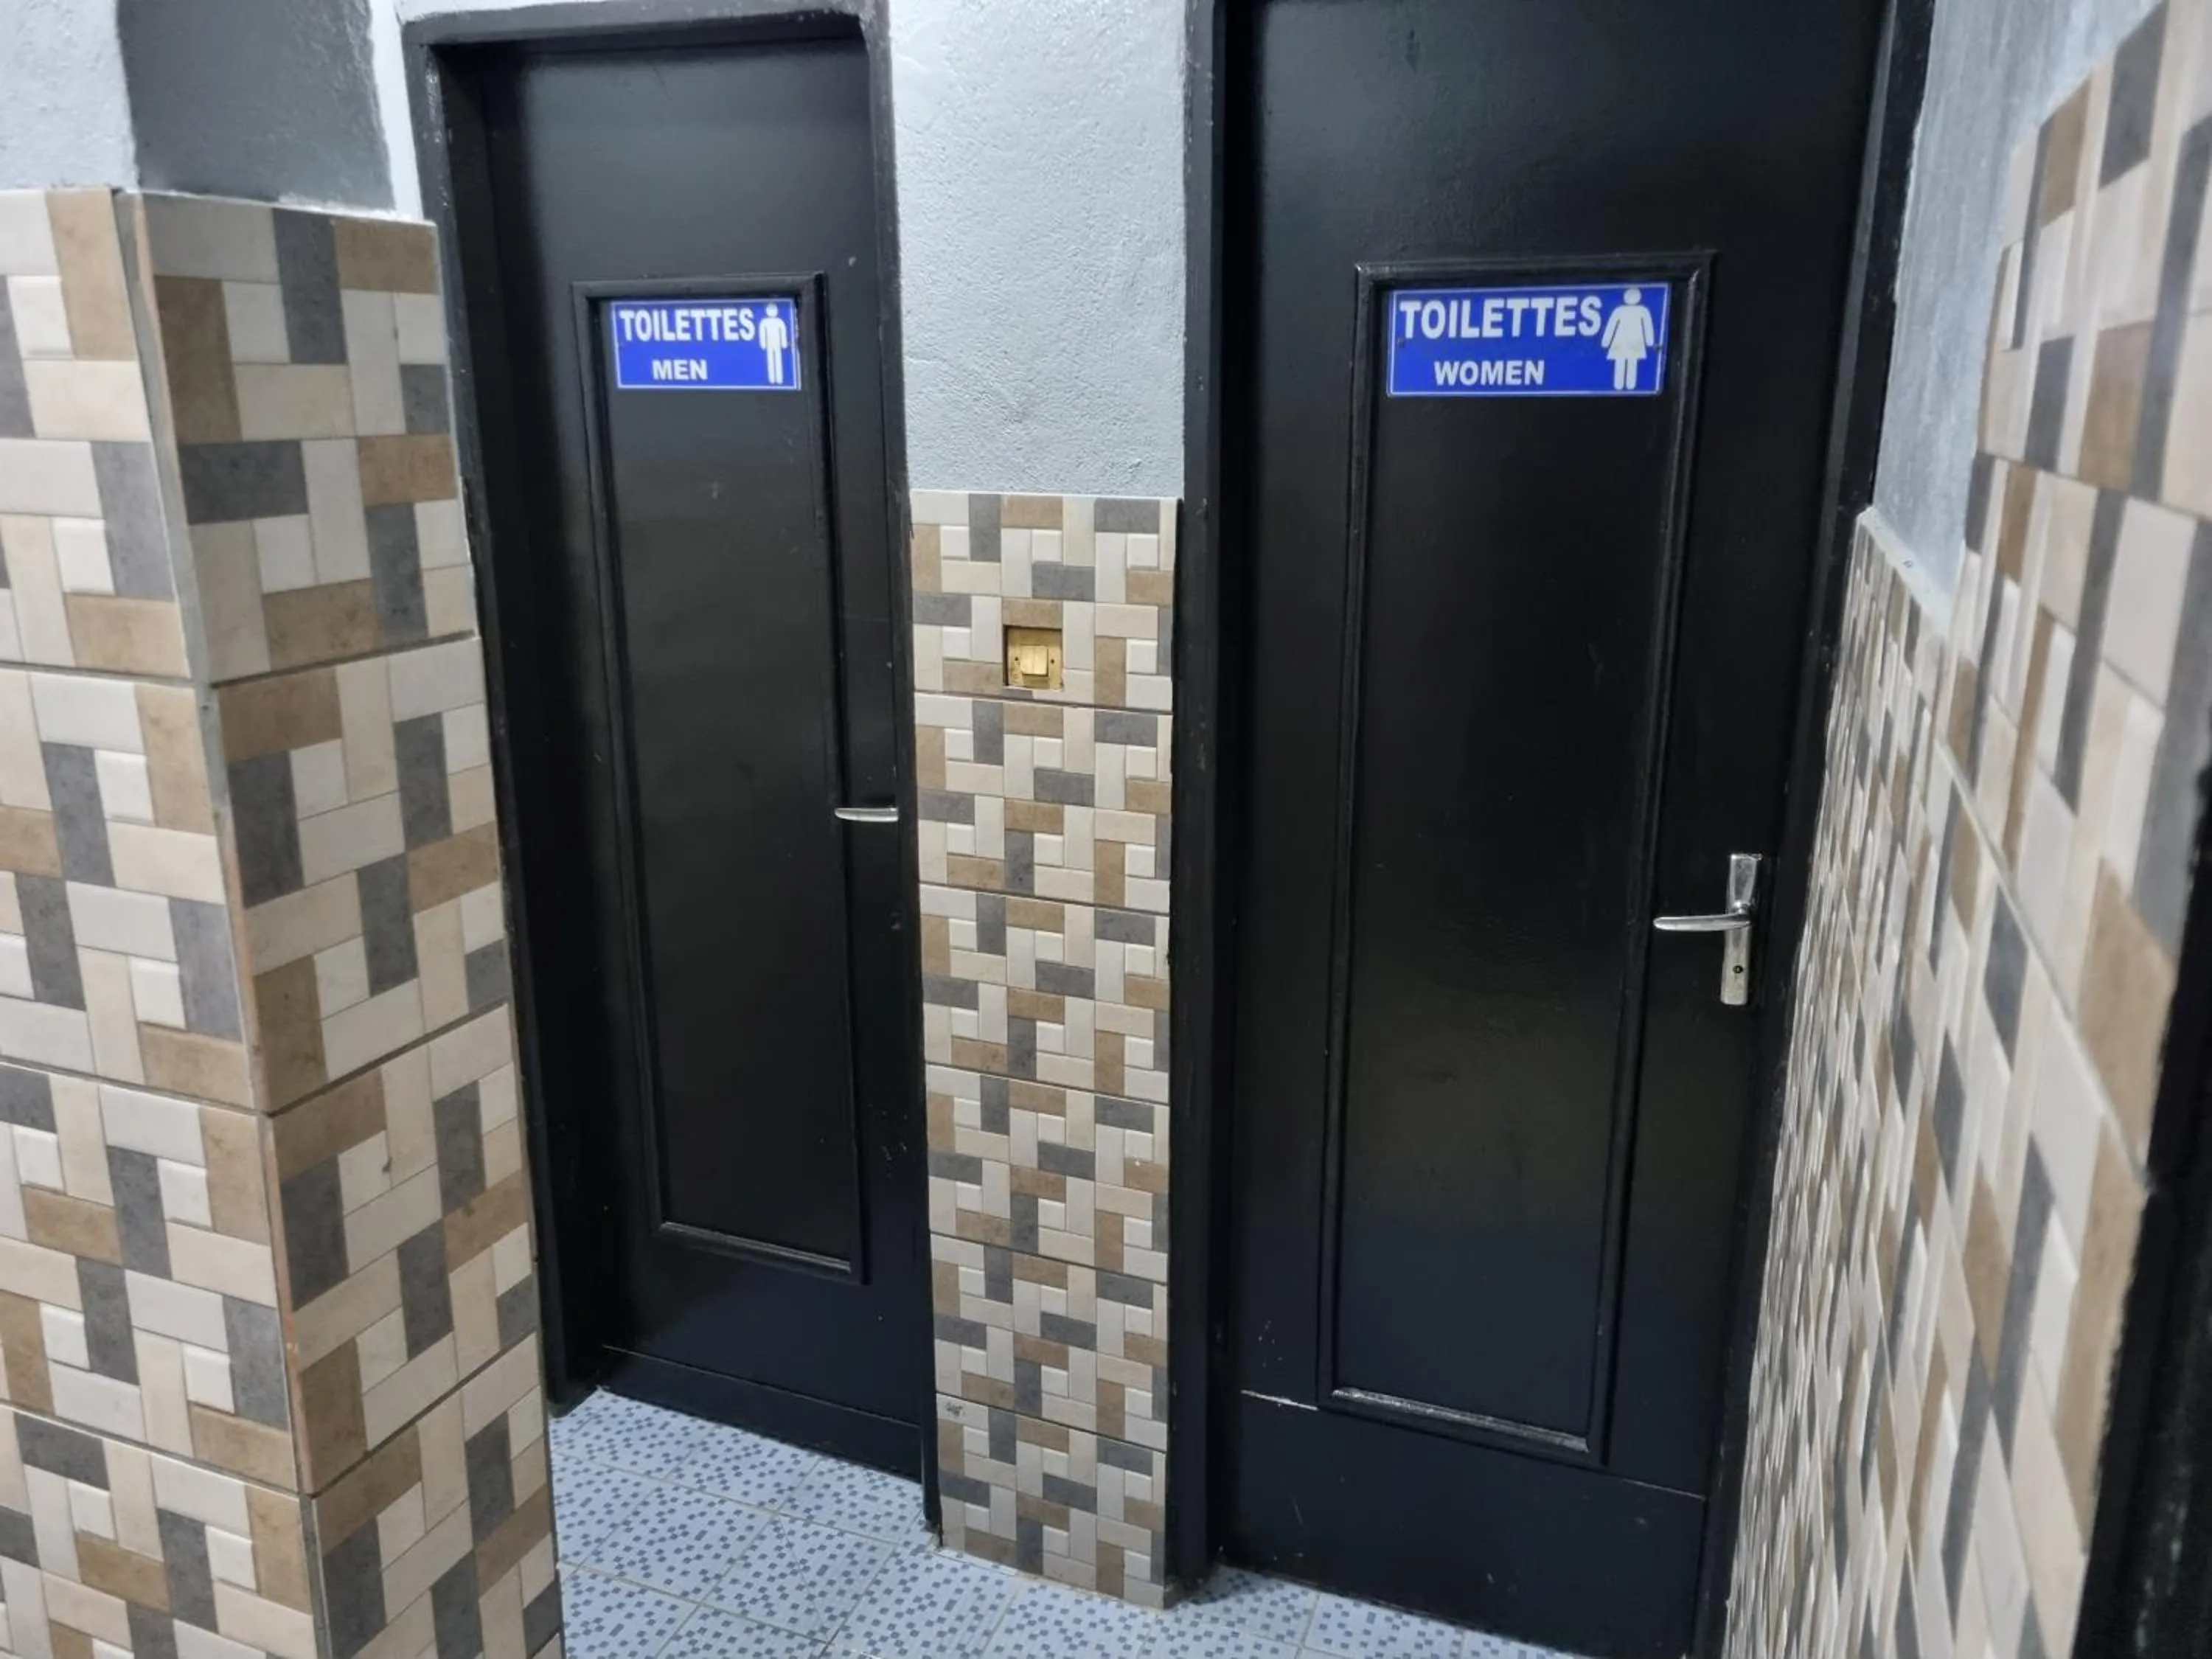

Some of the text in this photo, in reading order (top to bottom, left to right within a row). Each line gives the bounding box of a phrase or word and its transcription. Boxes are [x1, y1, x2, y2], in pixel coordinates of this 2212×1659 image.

[619, 307, 755, 341] TOILETTES
[1399, 296, 1602, 339] TOILETTES
[652, 359, 708, 380] MEN
[1434, 360, 1545, 386] WOMEN
